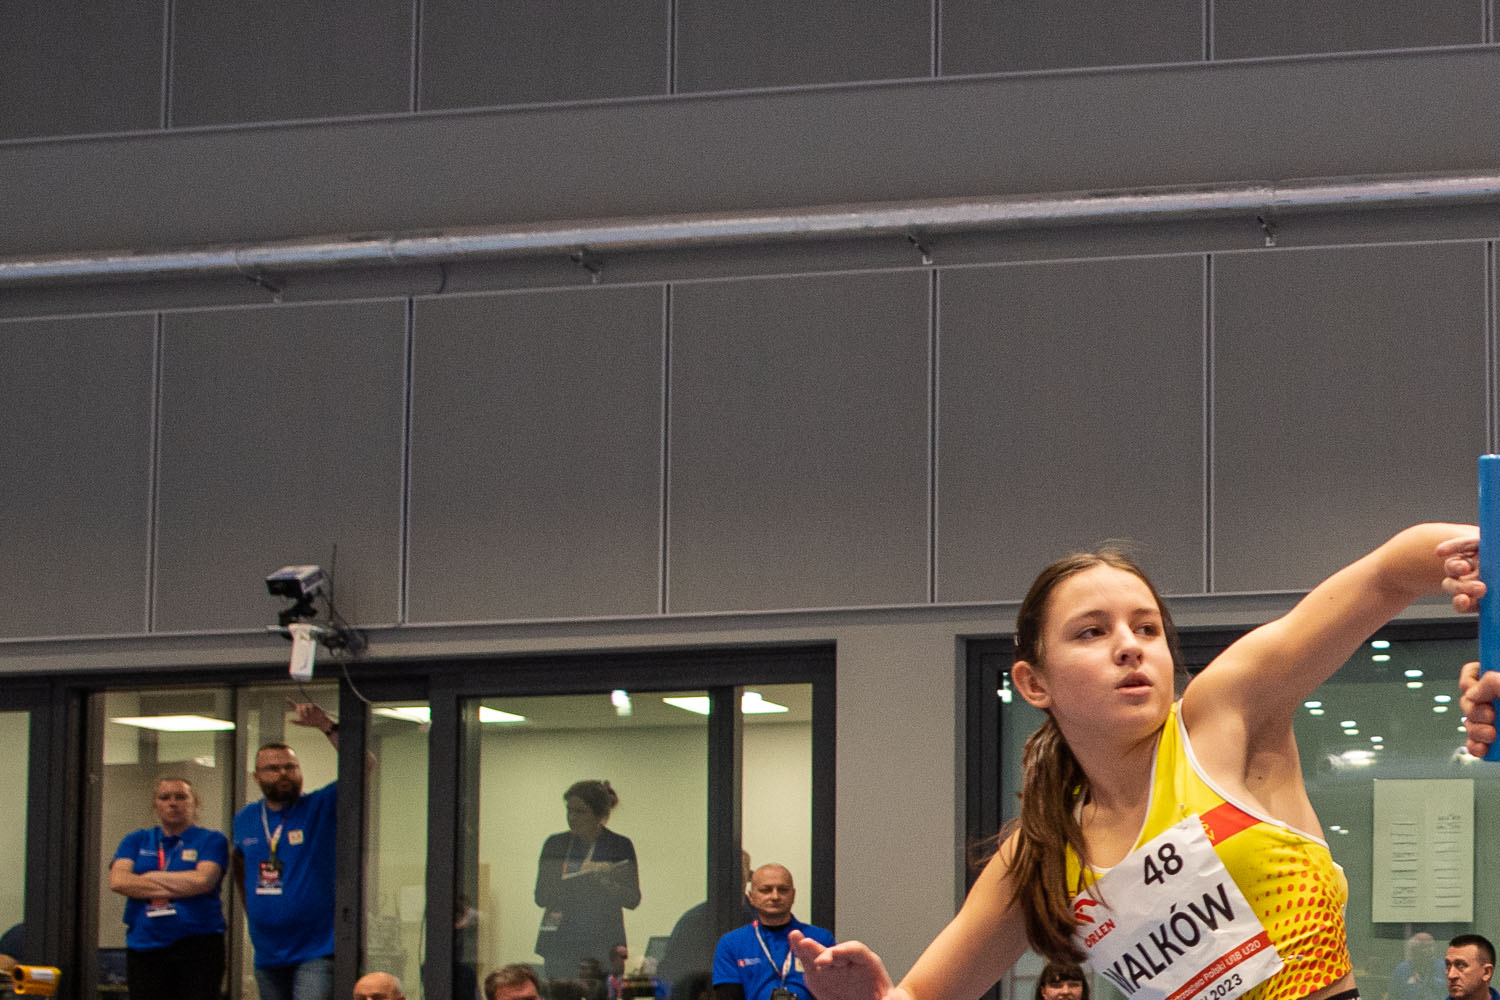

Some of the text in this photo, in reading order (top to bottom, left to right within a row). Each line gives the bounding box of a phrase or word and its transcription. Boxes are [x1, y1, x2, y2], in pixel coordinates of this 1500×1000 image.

[1143, 842, 1184, 886] 48
[1084, 918, 1116, 948] ORLEN
[1102, 883, 1235, 996] WALKÓW
[1241, 940, 1261, 956] U20
